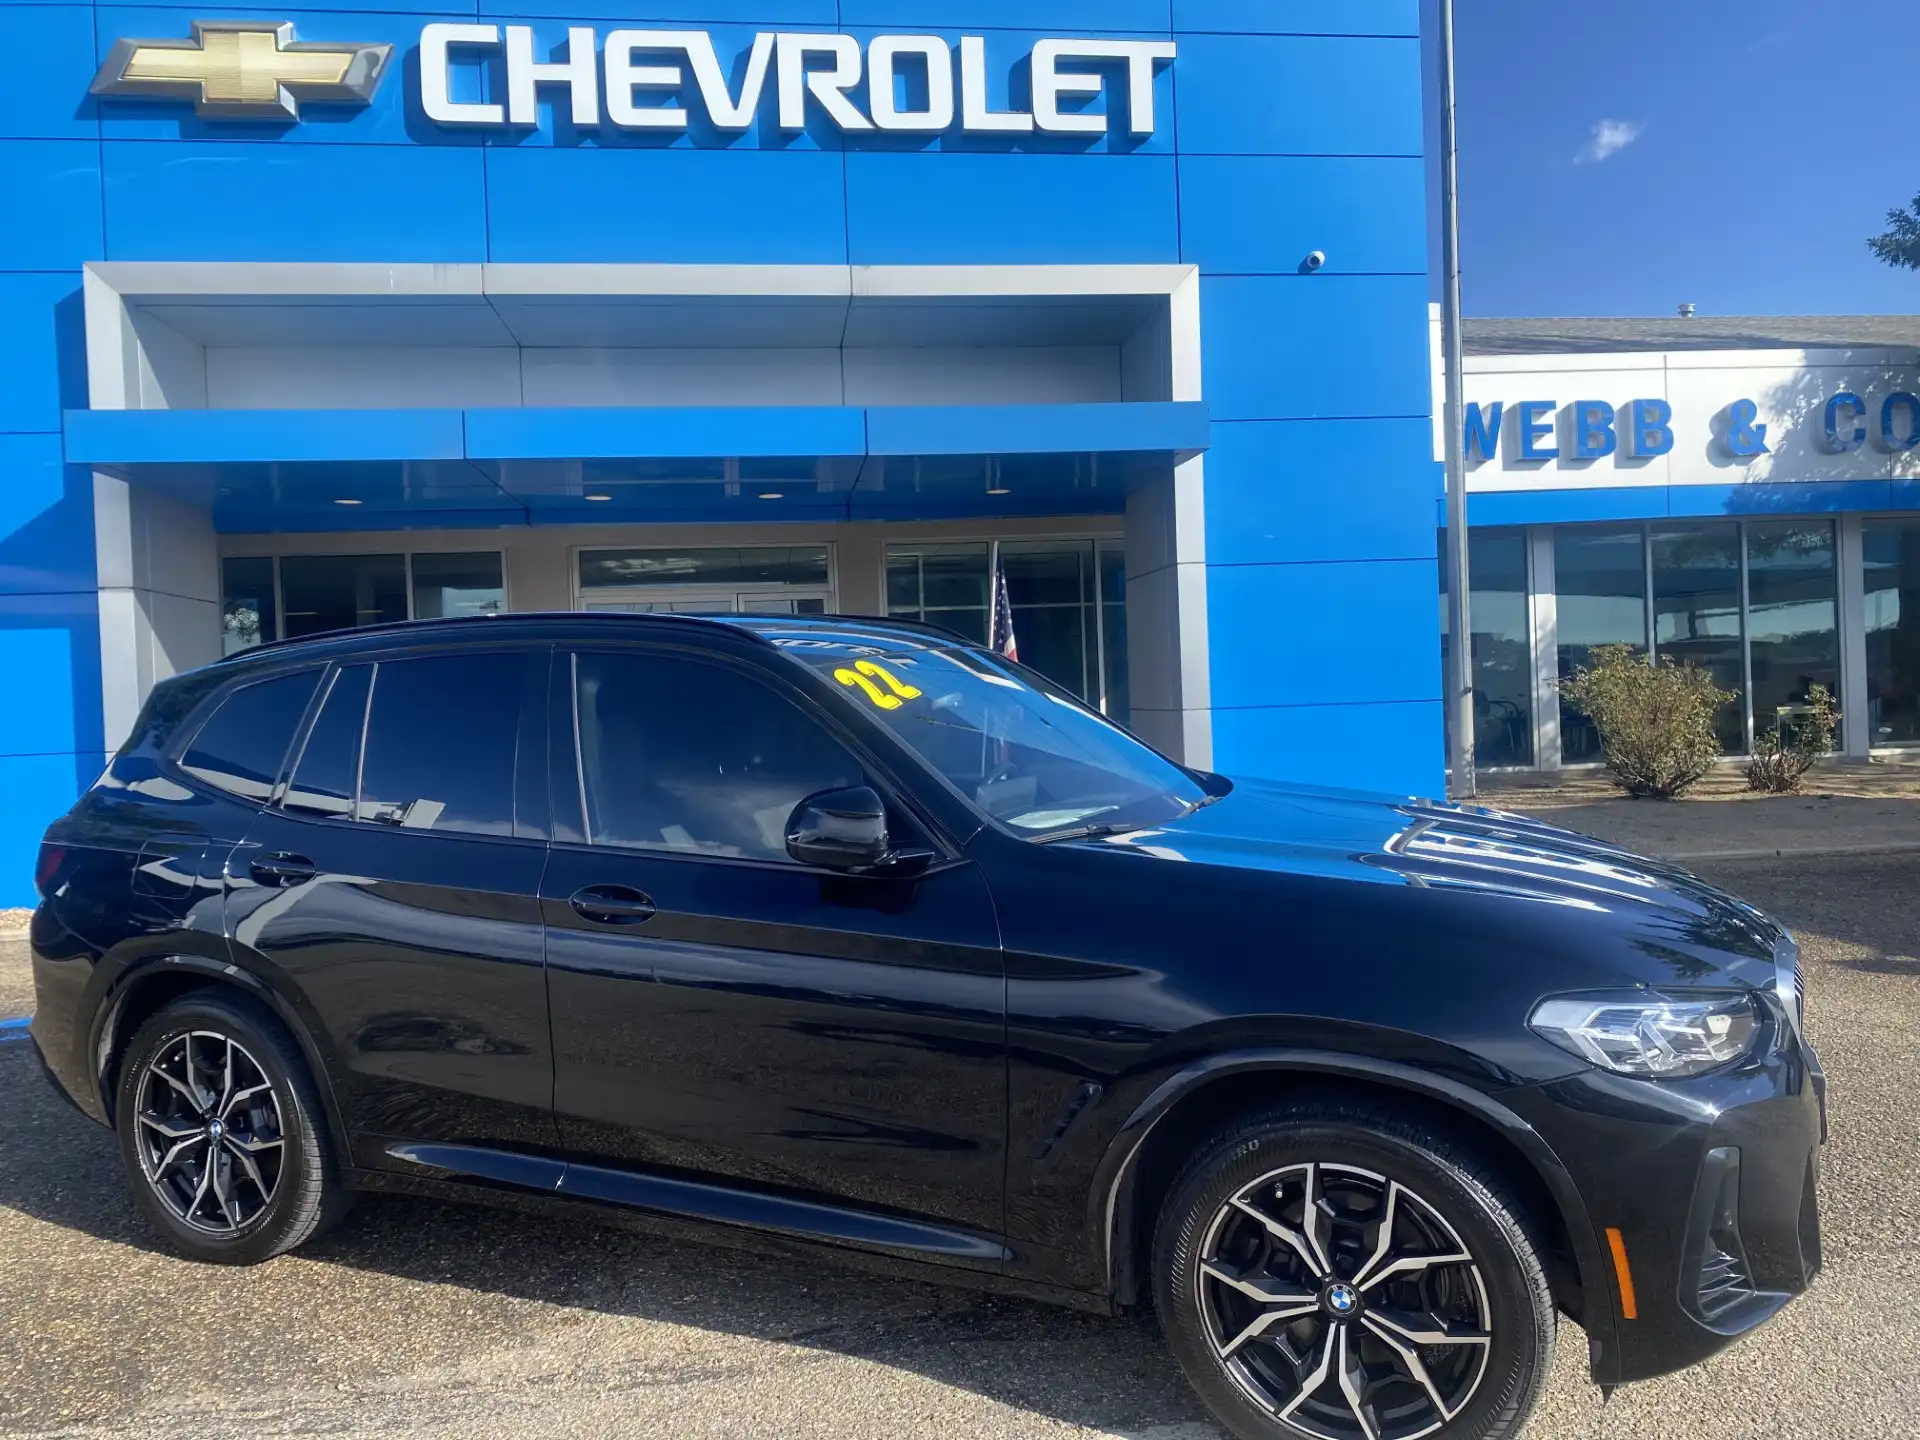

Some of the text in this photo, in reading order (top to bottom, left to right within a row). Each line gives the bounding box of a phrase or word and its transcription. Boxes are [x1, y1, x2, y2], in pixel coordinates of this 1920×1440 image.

[419, 23, 1177, 134] CHEVROLET
[1729, 398, 1771, 456] &
[833, 660, 922, 710] 22
